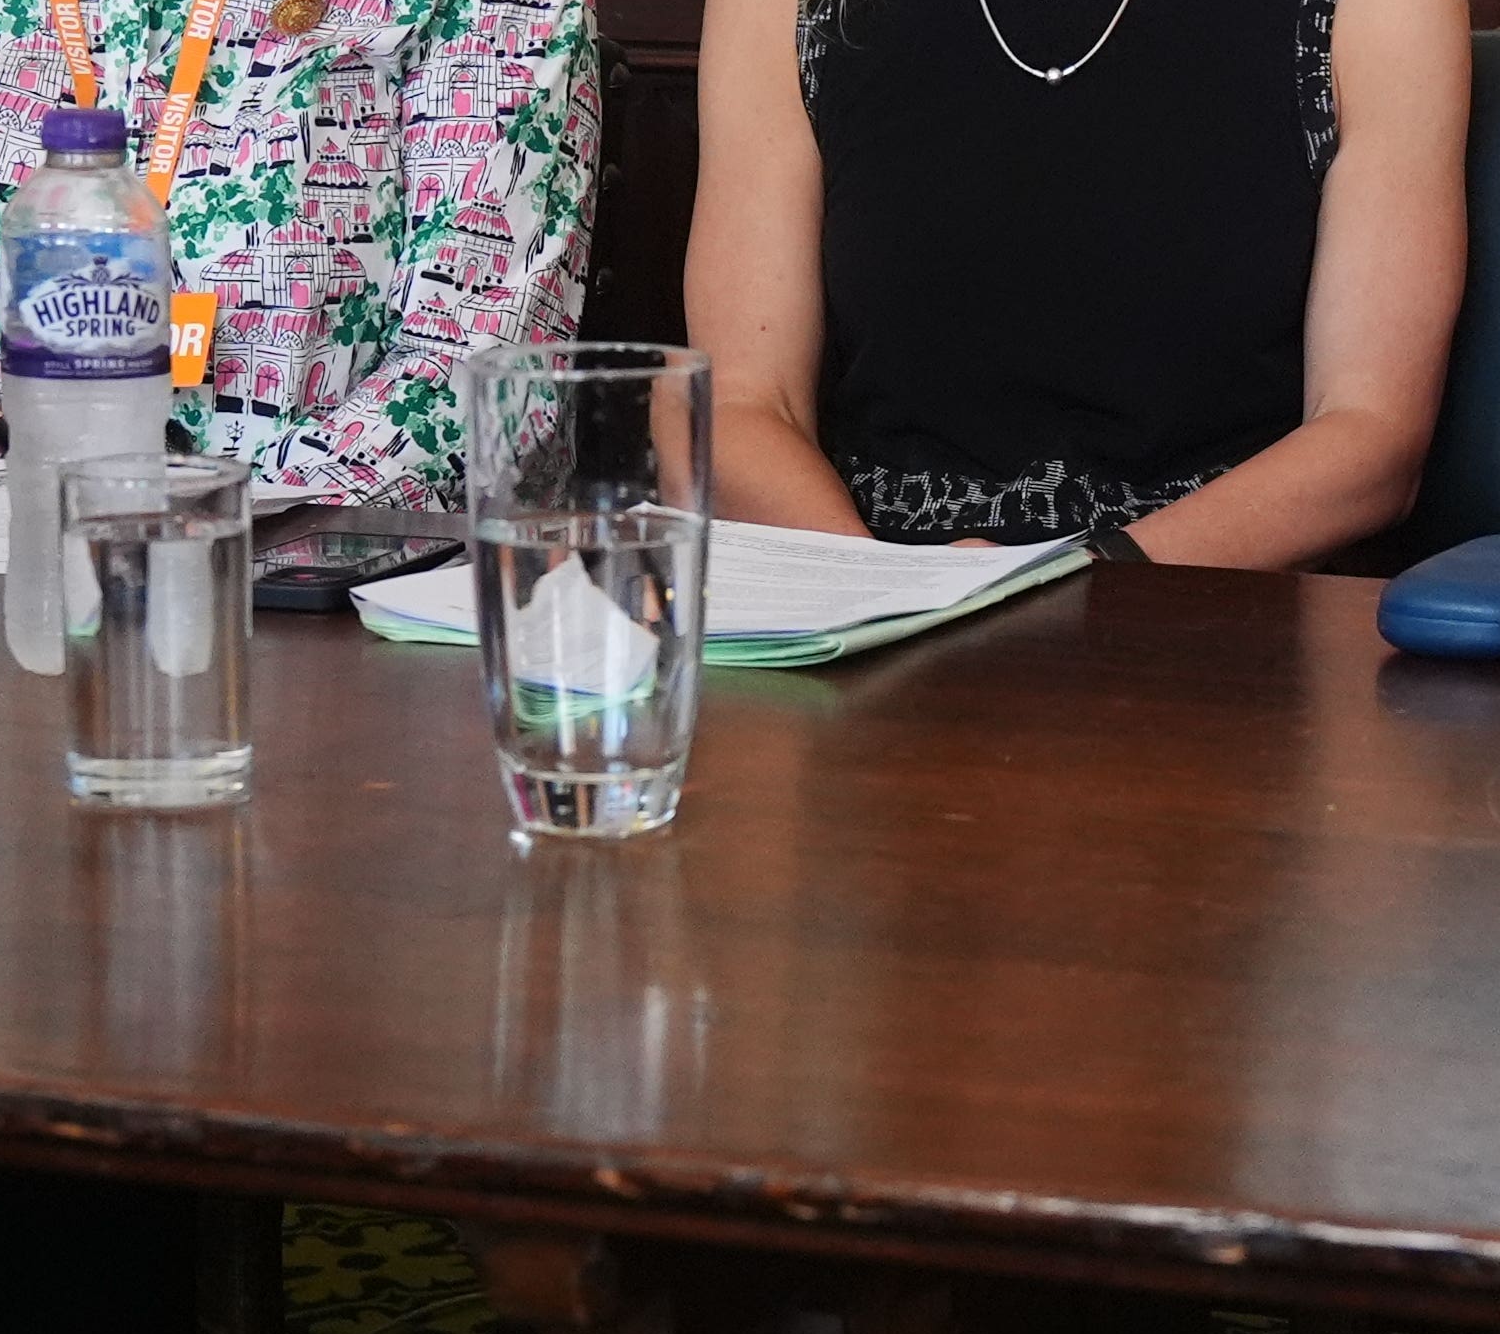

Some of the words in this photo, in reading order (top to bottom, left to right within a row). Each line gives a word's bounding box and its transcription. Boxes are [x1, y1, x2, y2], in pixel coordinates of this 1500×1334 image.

[55, 3, 92, 76] VISITOR
[151, 93, 192, 174] VISITOR
[33, 290, 161, 328] HIGHLAND
[66, 318, 136, 338] SPRING
[74, 358, 125, 369] SPRING
